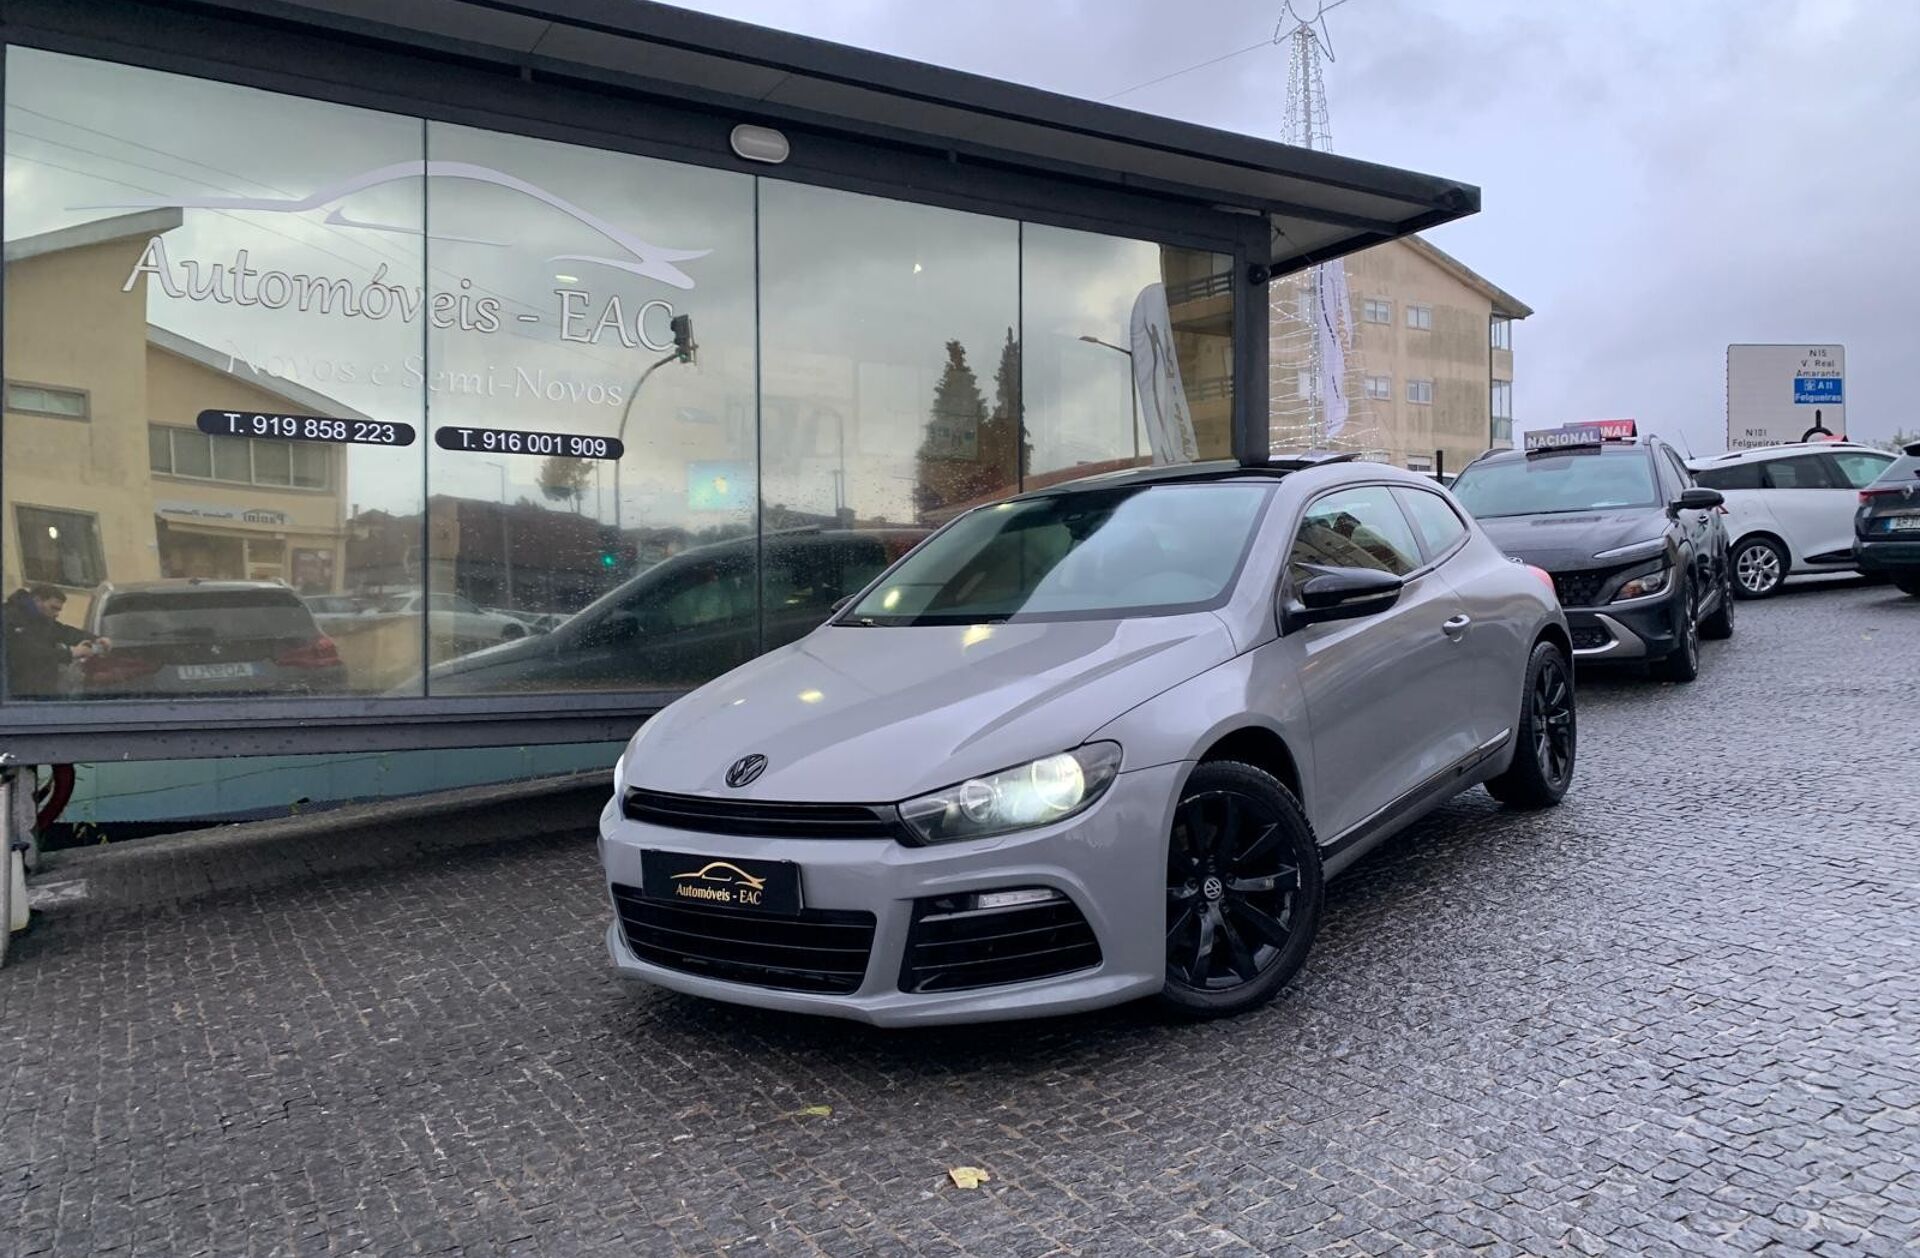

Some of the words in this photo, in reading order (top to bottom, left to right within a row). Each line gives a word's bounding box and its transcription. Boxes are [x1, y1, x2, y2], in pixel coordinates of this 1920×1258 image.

[120, 234, 501, 334] Automóveis
[554, 288, 679, 352] EAC
[1809, 349, 1828, 357] N15
[1814, 359, 1835, 367] Real
[1796, 369, 1841, 378] Amarante
[1795, 393, 1842, 403] Felgueiras
[223, 413, 245, 433] T.
[252, 415, 297, 436] 919
[304, 418, 347, 440] 858
[354, 422, 395, 443] 223
[458, 429, 476, 448] T.
[483, 431, 521, 451] 916
[527, 434, 563, 454] 001
[570, 437, 607, 456] 909
[1526, 431, 1600, 449] NACIONAL
[1732, 439, 1782, 449] Felgueiras
[676, 883, 730, 901] Automóveis
[739, 889, 762, 905] EAC
